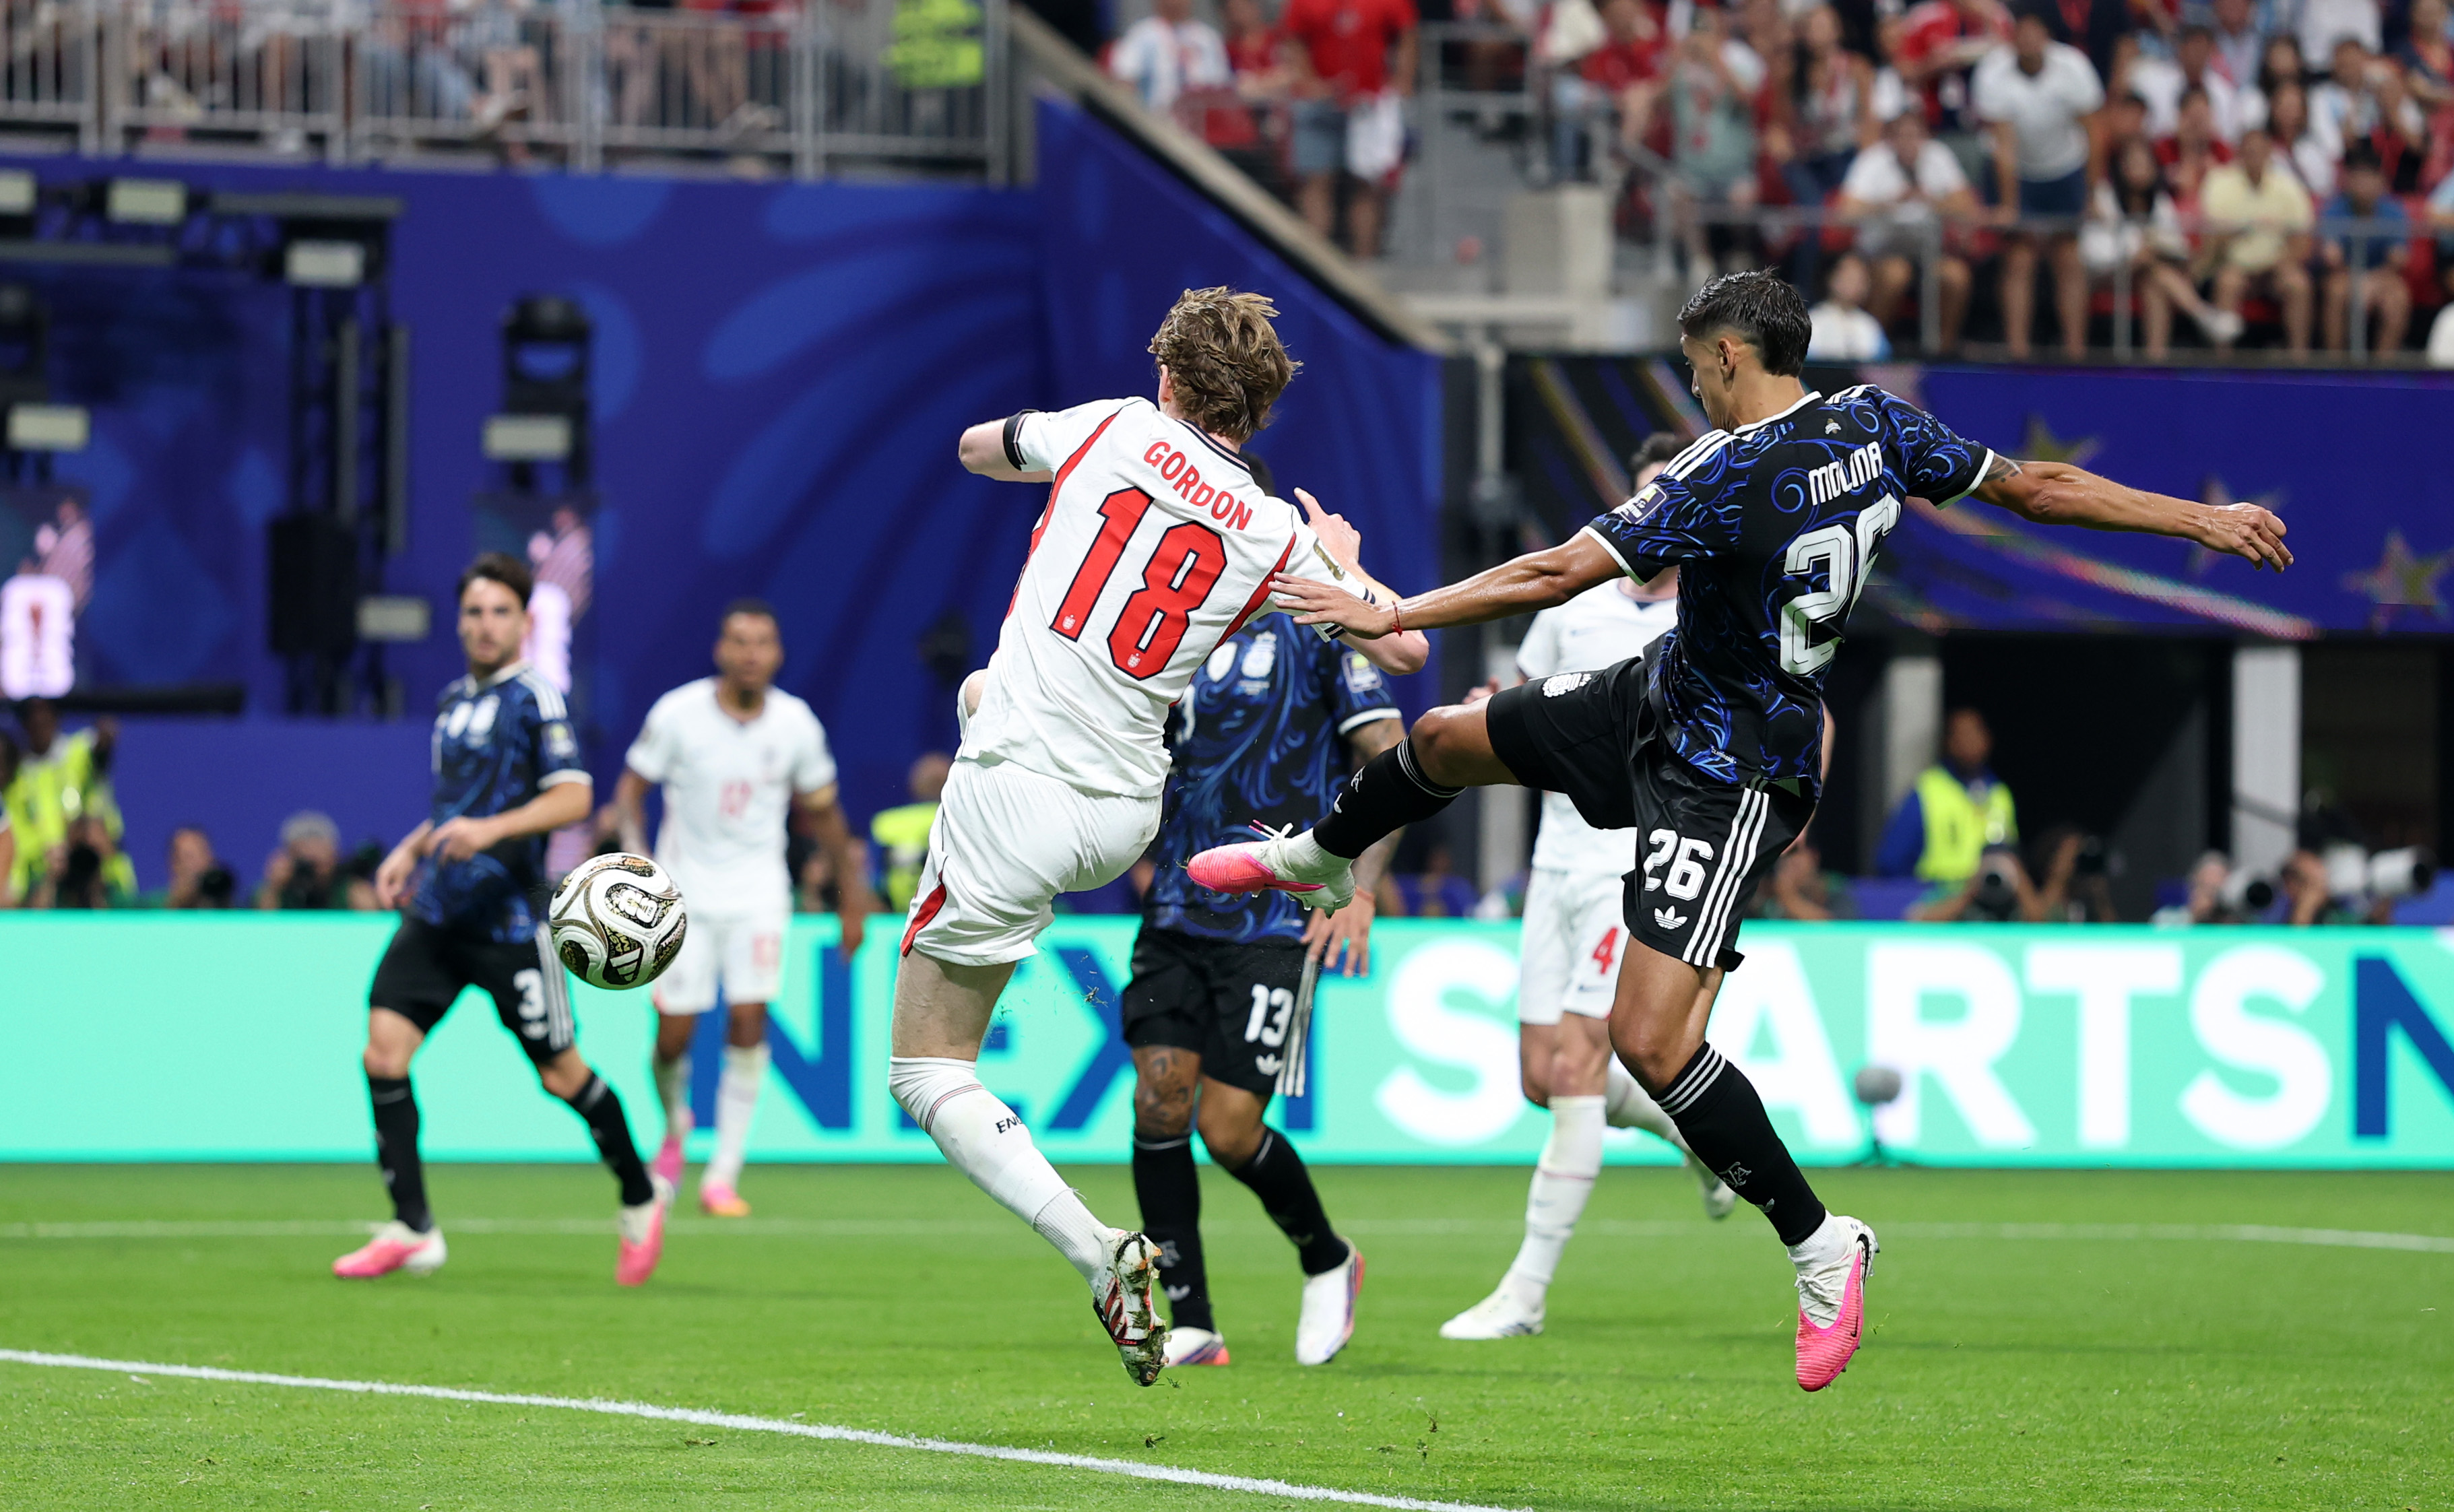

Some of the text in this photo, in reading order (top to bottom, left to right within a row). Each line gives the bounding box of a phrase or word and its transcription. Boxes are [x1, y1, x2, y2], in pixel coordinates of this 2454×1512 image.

[1143, 441, 1253, 531] GORDON
[1808, 441, 1883, 506] MOLINA
[1049, 486, 1227, 681] 18
[1643, 828, 1714, 901] 26
[1592, 927, 1618, 975] 4
[513, 968, 545, 1020] 3
[1244, 983, 1294, 1047] 13
